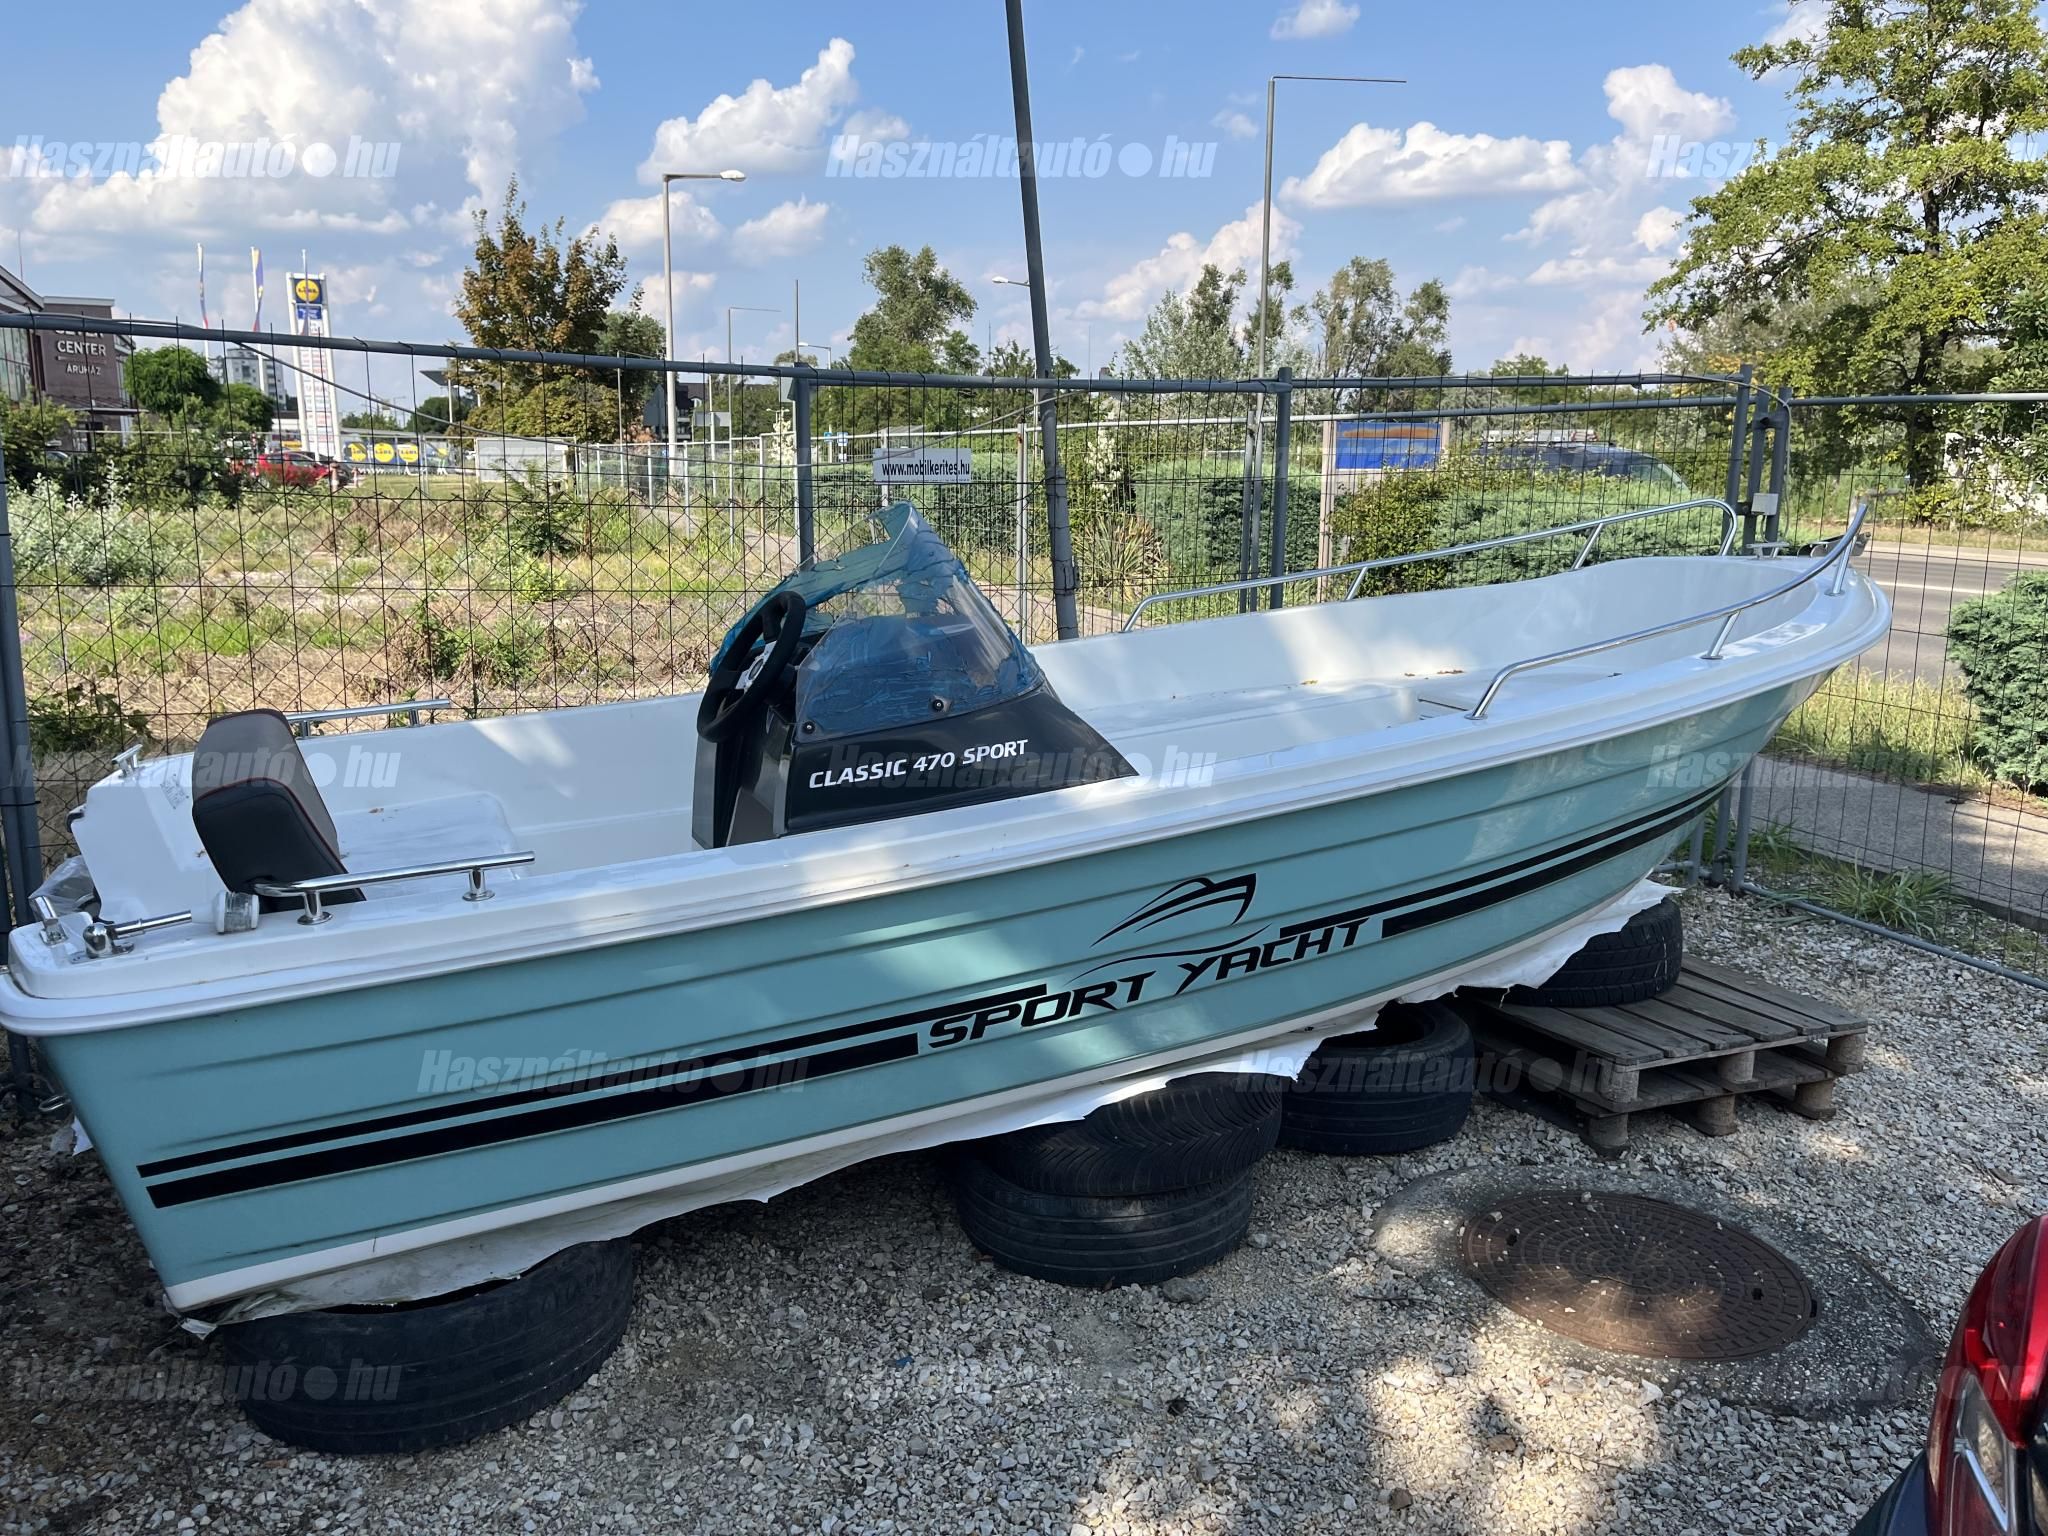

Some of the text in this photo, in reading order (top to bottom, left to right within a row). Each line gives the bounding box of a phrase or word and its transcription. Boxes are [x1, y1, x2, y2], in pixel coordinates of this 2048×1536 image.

[57, 340, 106, 356] CENTER
[881, 459, 971, 476] www.mobilkerites.hu
[809, 739, 1029, 788] CLASSIC 470 SPORT
[929, 917, 1371, 1050] SPORT YACHT
